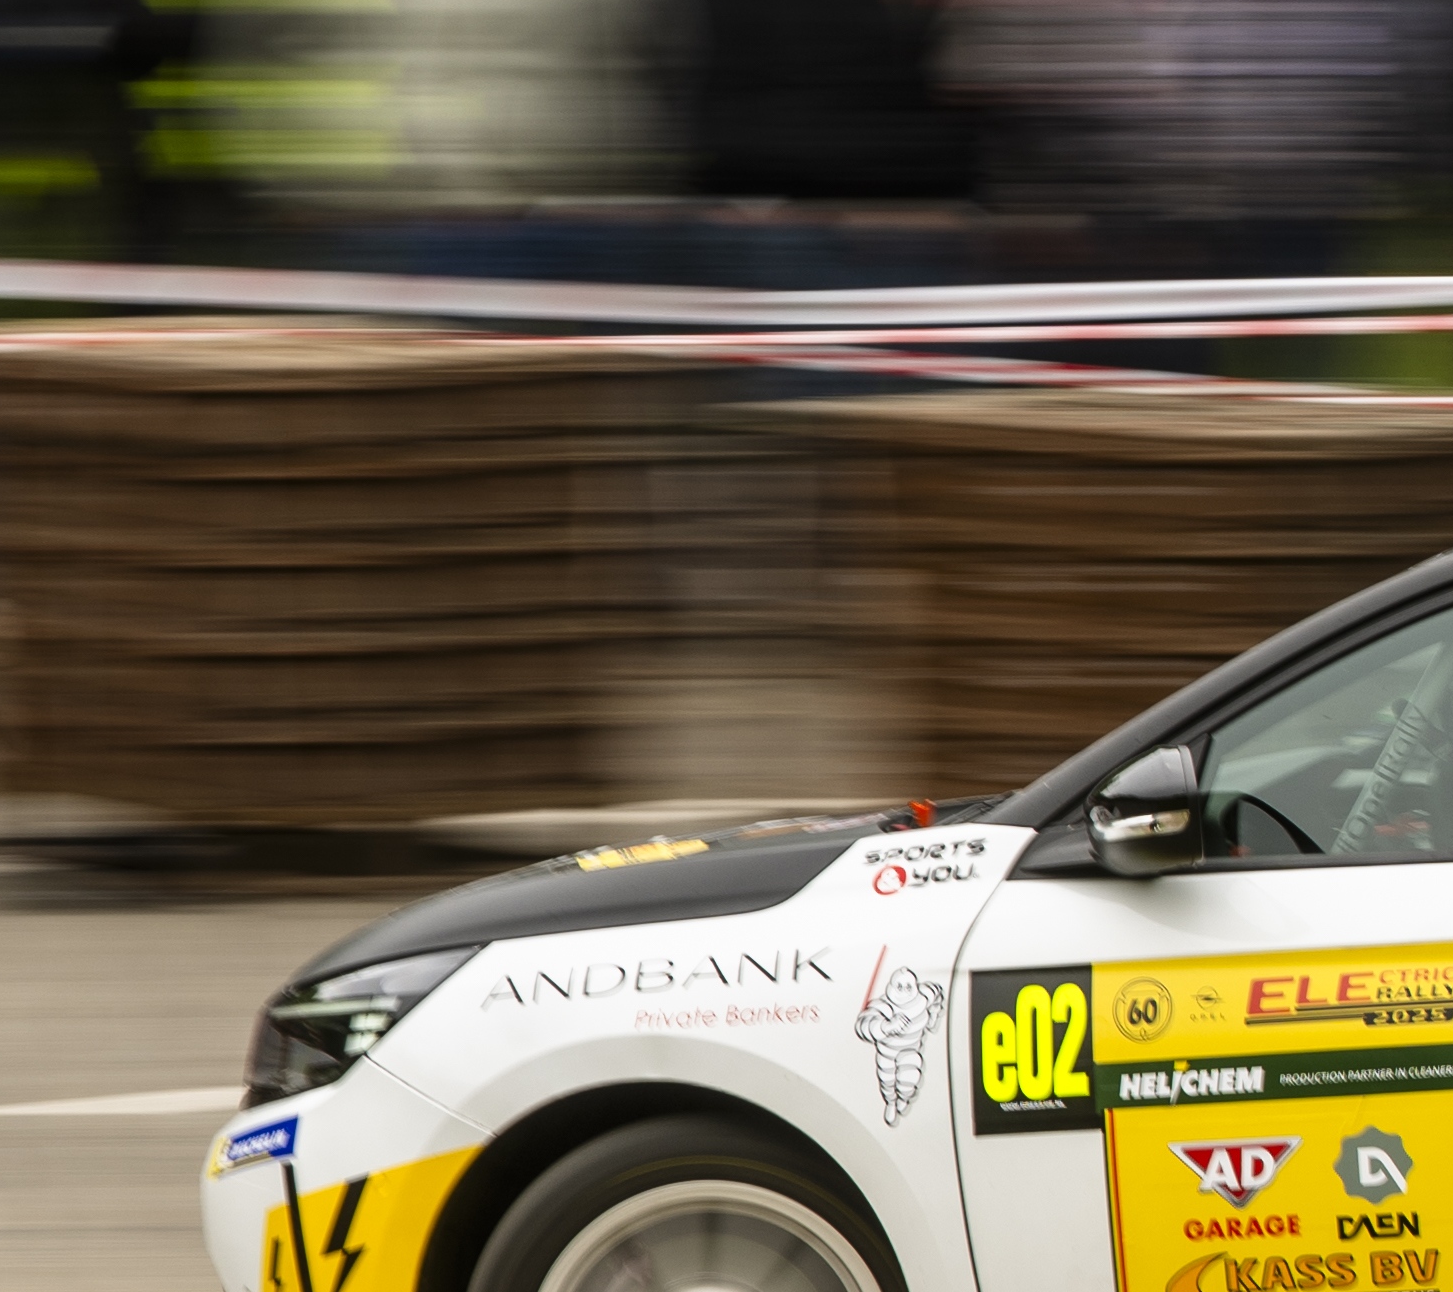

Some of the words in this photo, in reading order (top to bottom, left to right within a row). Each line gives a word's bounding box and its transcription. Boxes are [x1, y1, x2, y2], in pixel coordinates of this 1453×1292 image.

[865, 838, 986, 865] SPORTS
[481, 947, 833, 1012] ANDBANK
[634, 1006, 718, 1030] Private
[725, 1003, 821, 1027] Bankers
[1127, 997, 1159, 1026] 60
[1372, 1007, 1447, 1025] 2025
[982, 983, 1091, 1102] e02
[1280, 1070, 1346, 1087] PRODUCTION
[1348, 1068, 1394, 1083] PARTNER
[1199, 1144, 1277, 1192] AD
[1183, 1214, 1302, 1241] GARAGE
[1224, 1252, 1358, 1292] KASS
[1370, 1248, 1441, 1287] BV
